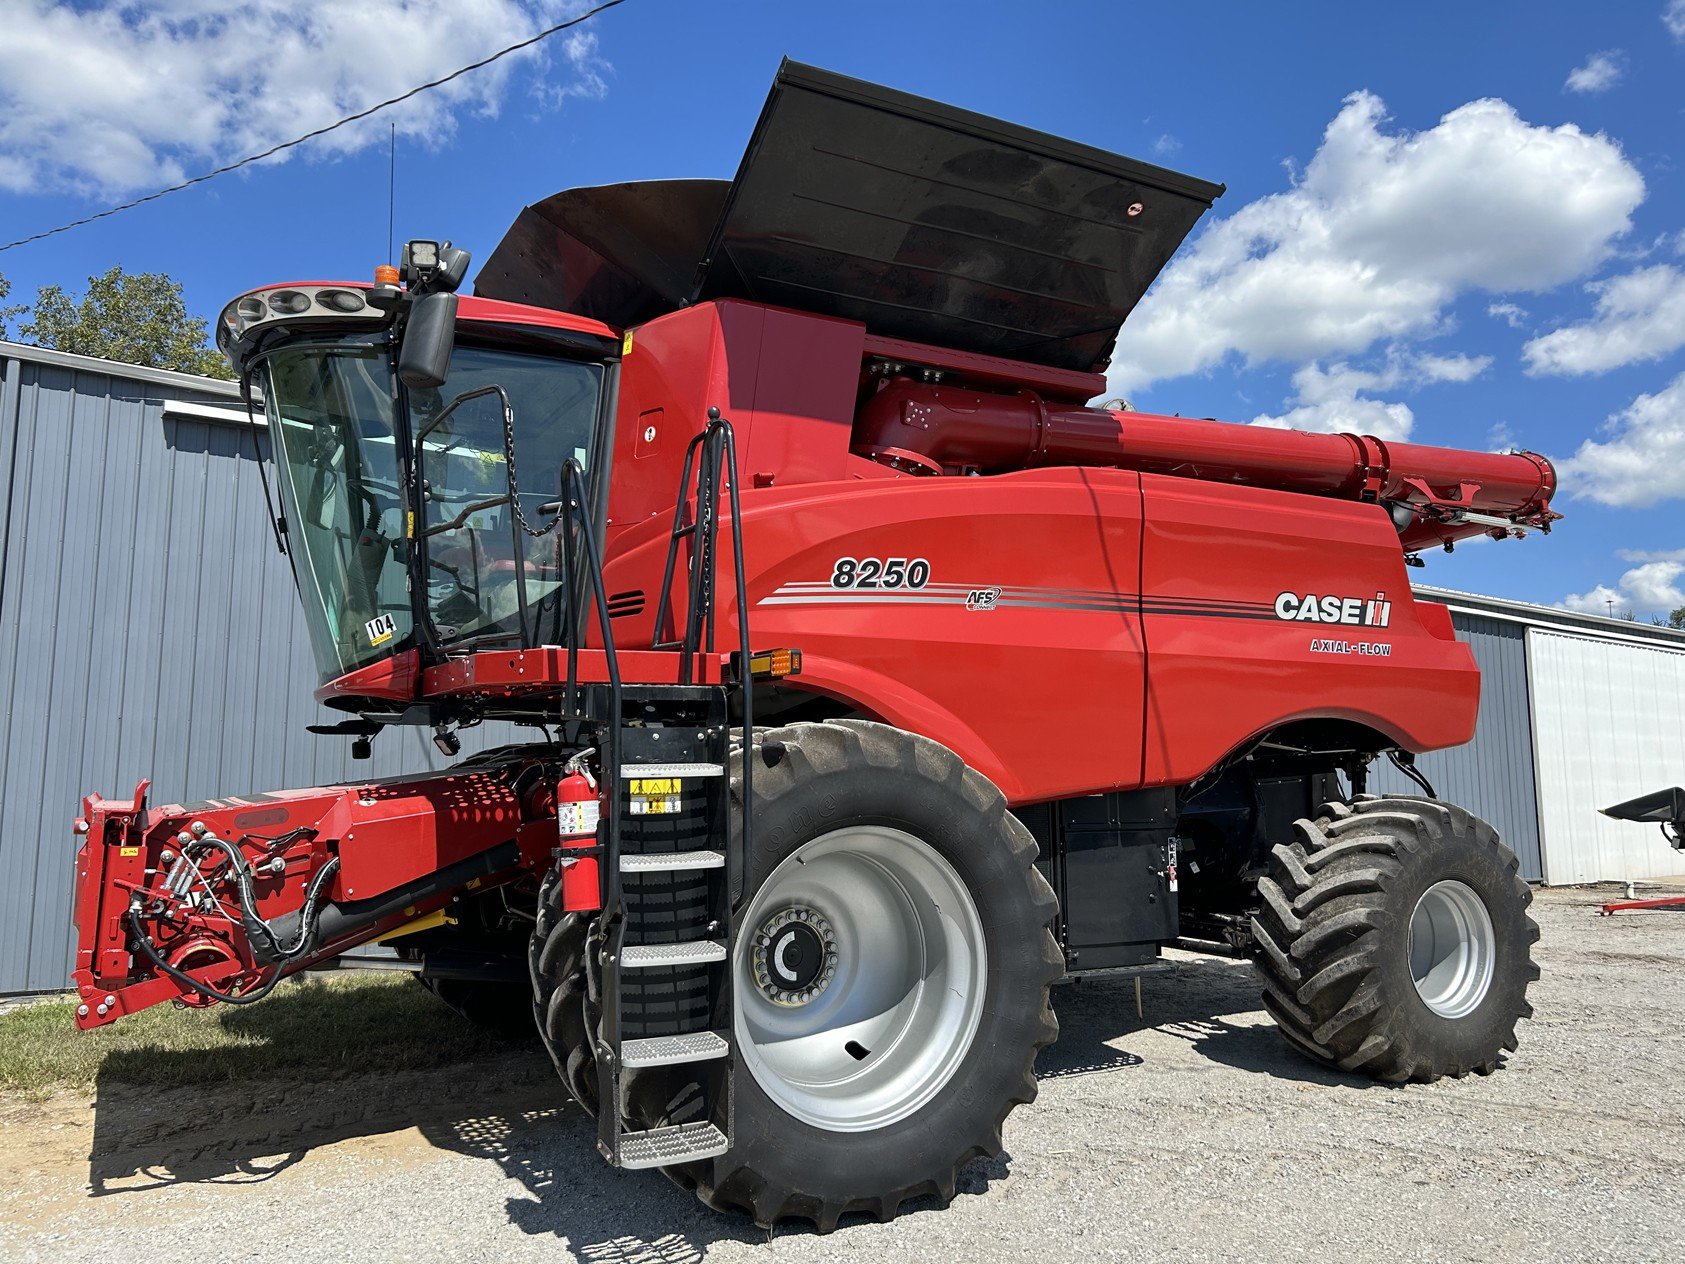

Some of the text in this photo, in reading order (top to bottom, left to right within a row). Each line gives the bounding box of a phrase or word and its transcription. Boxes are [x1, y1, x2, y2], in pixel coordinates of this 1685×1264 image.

[831, 557, 930, 590] 8250
[966, 590, 995, 604] AFS
[1275, 592, 1362, 624] CASE
[368, 614, 394, 639] 104
[1310, 639, 1391, 656] AXIAL-FLOW
